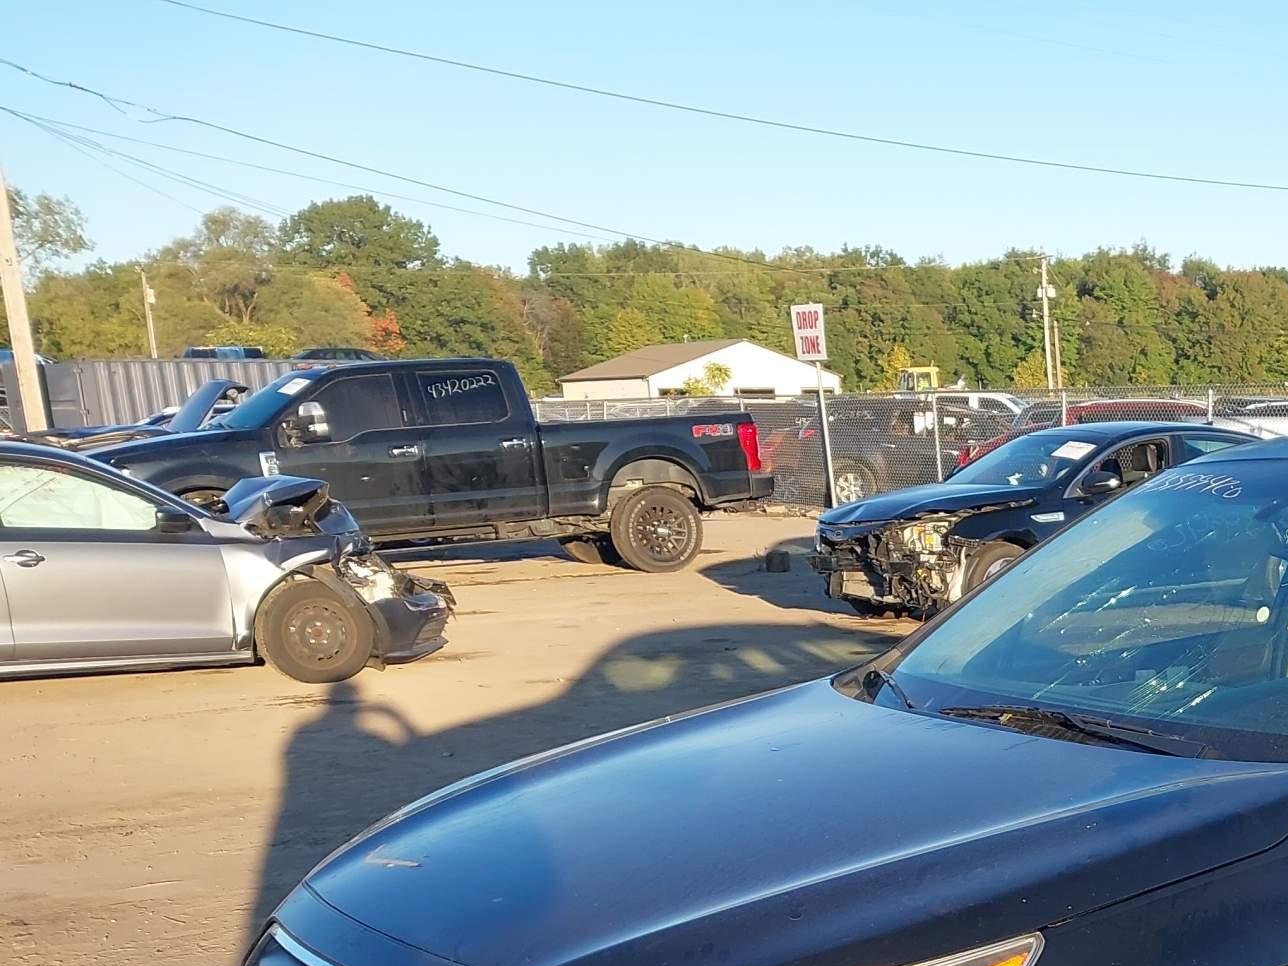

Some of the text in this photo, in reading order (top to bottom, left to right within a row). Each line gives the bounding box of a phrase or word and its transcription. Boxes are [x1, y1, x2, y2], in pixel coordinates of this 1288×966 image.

[796, 311, 819, 330] DROP
[800, 335, 821, 355] ZONE
[427, 374, 497, 399] 43420222
